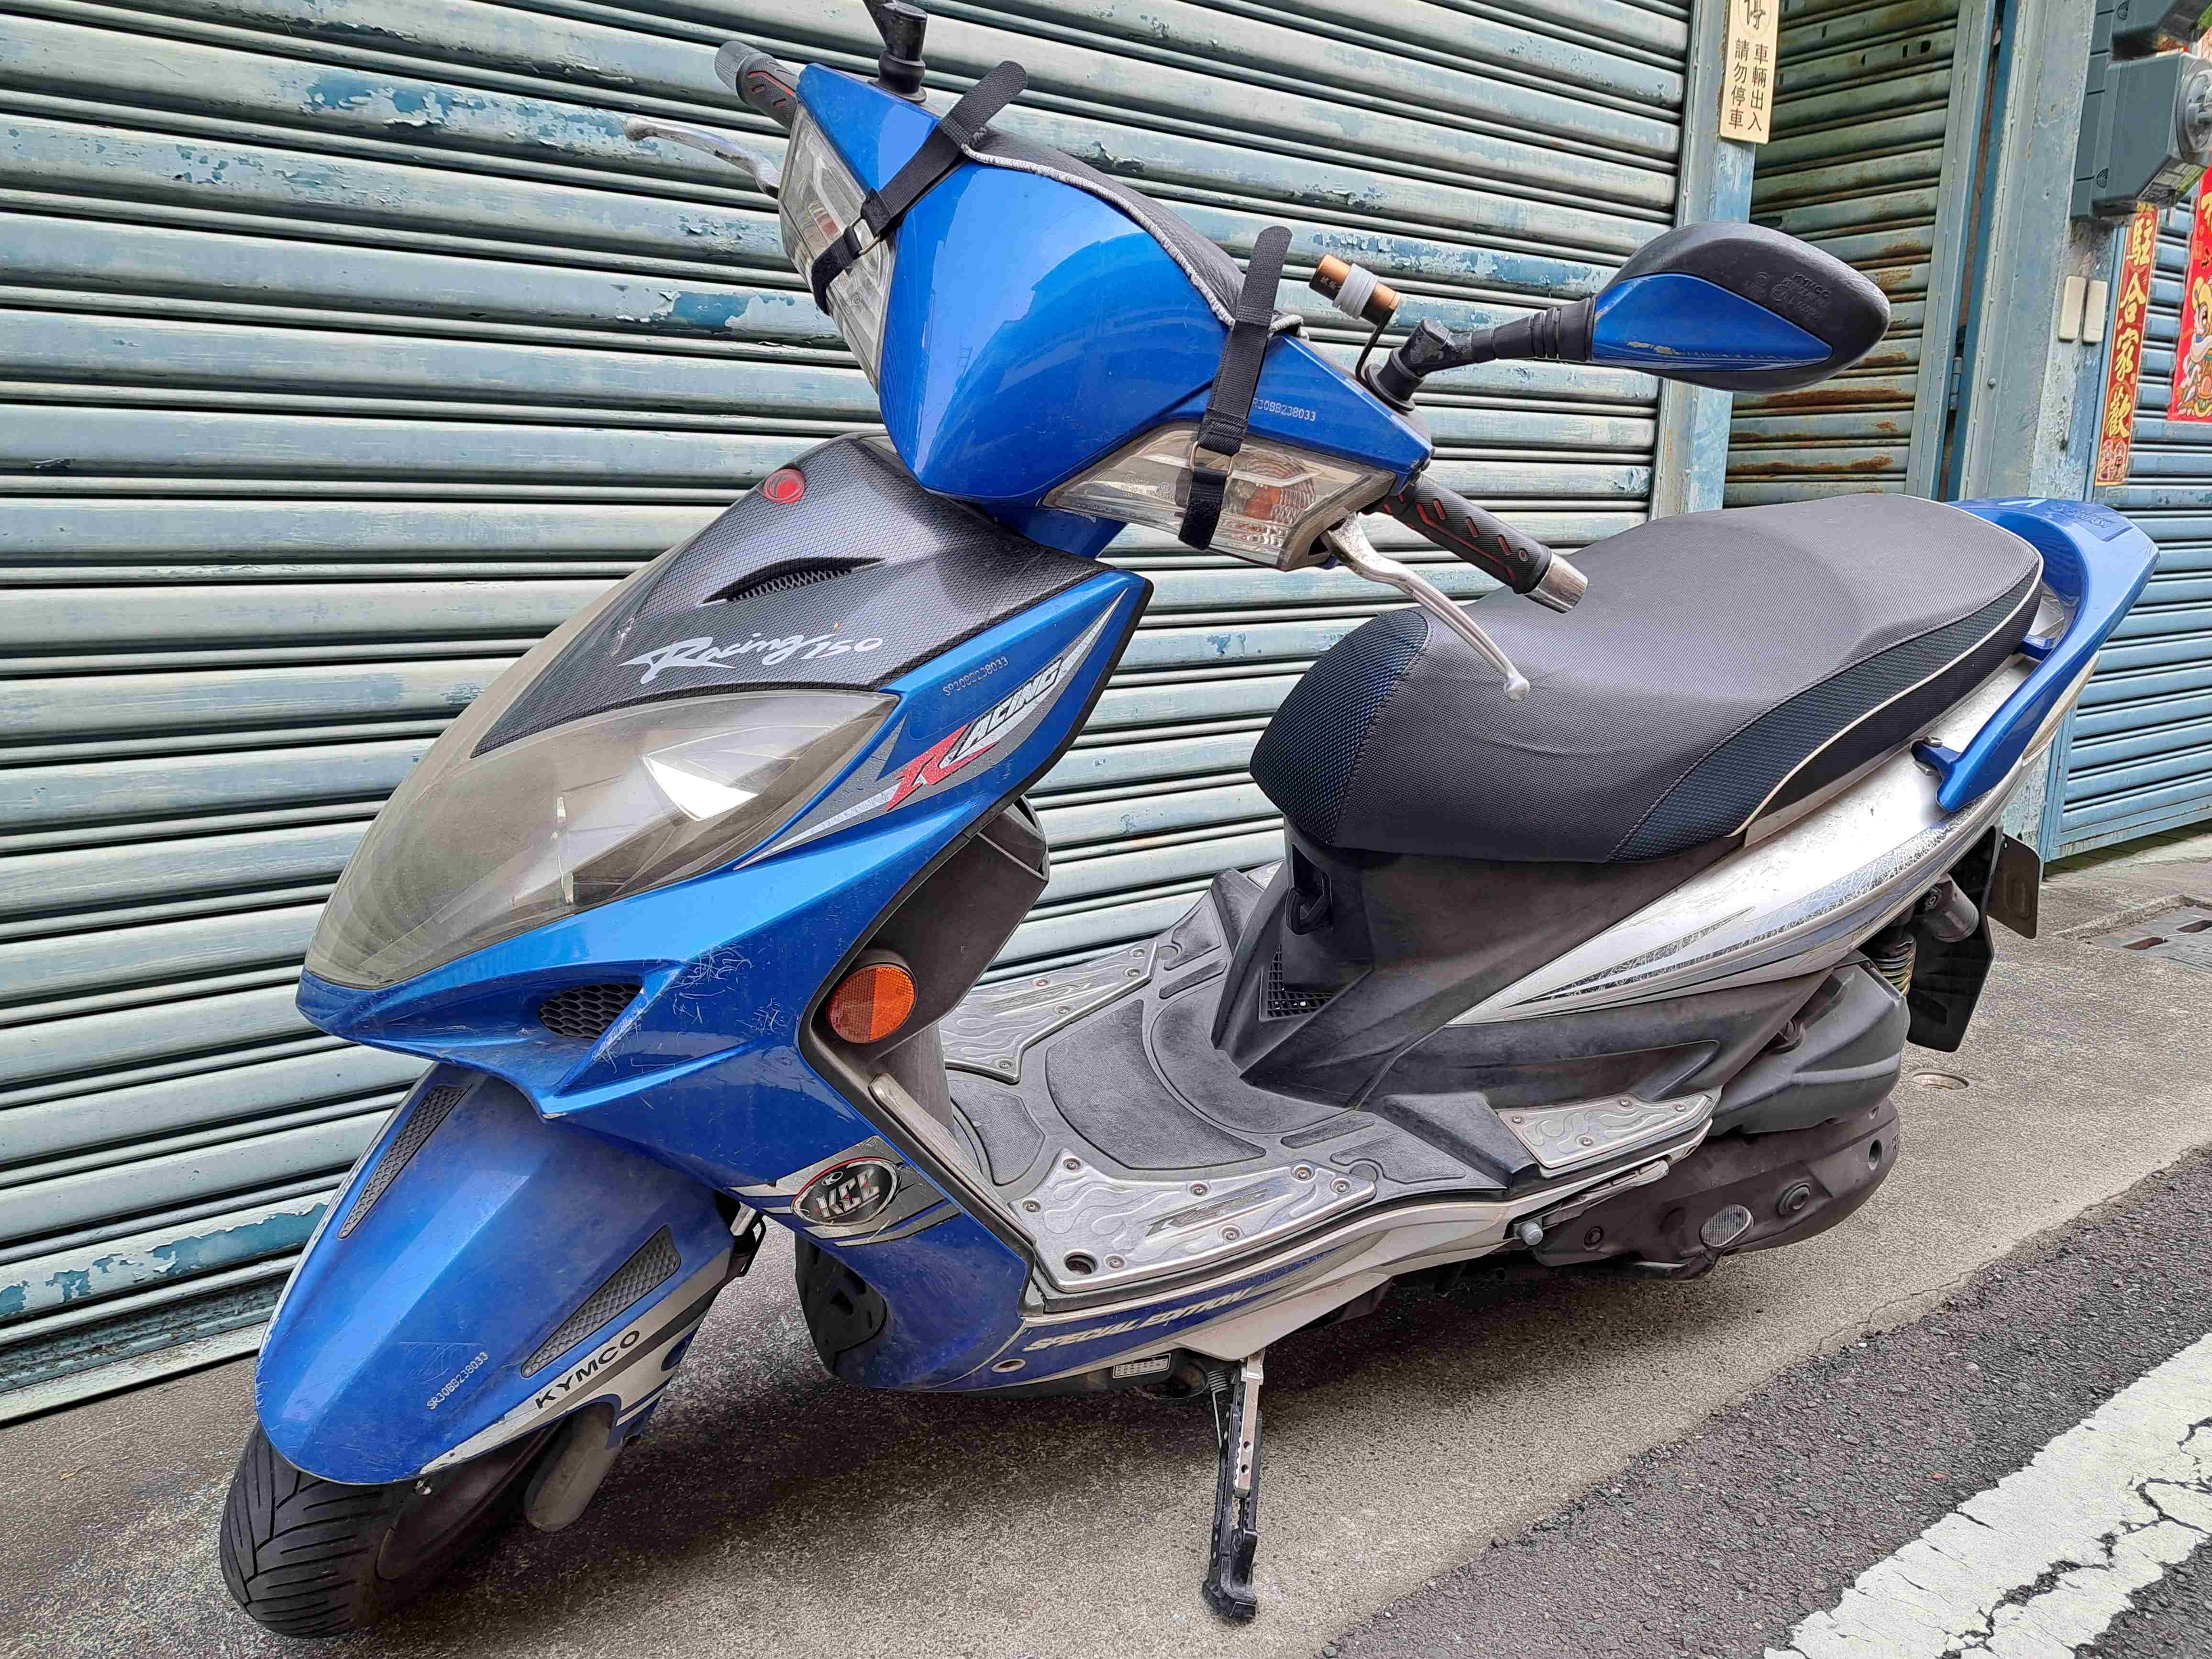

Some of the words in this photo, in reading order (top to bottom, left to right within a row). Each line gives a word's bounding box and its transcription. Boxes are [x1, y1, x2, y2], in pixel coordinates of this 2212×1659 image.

[1728, 37, 1750, 130] 請勿停車
[1747, 43, 1769, 132] 車輛出入
[2106, 203, 2155, 439] 駐合家歡
[618, 632, 840, 685] Racing
[800, 637, 884, 660] 150
[1139, 1287, 1255, 1327] EDITION
[426, 1351, 489, 1410] SR30BB238033
[534, 1330, 640, 1409] KYMCO
